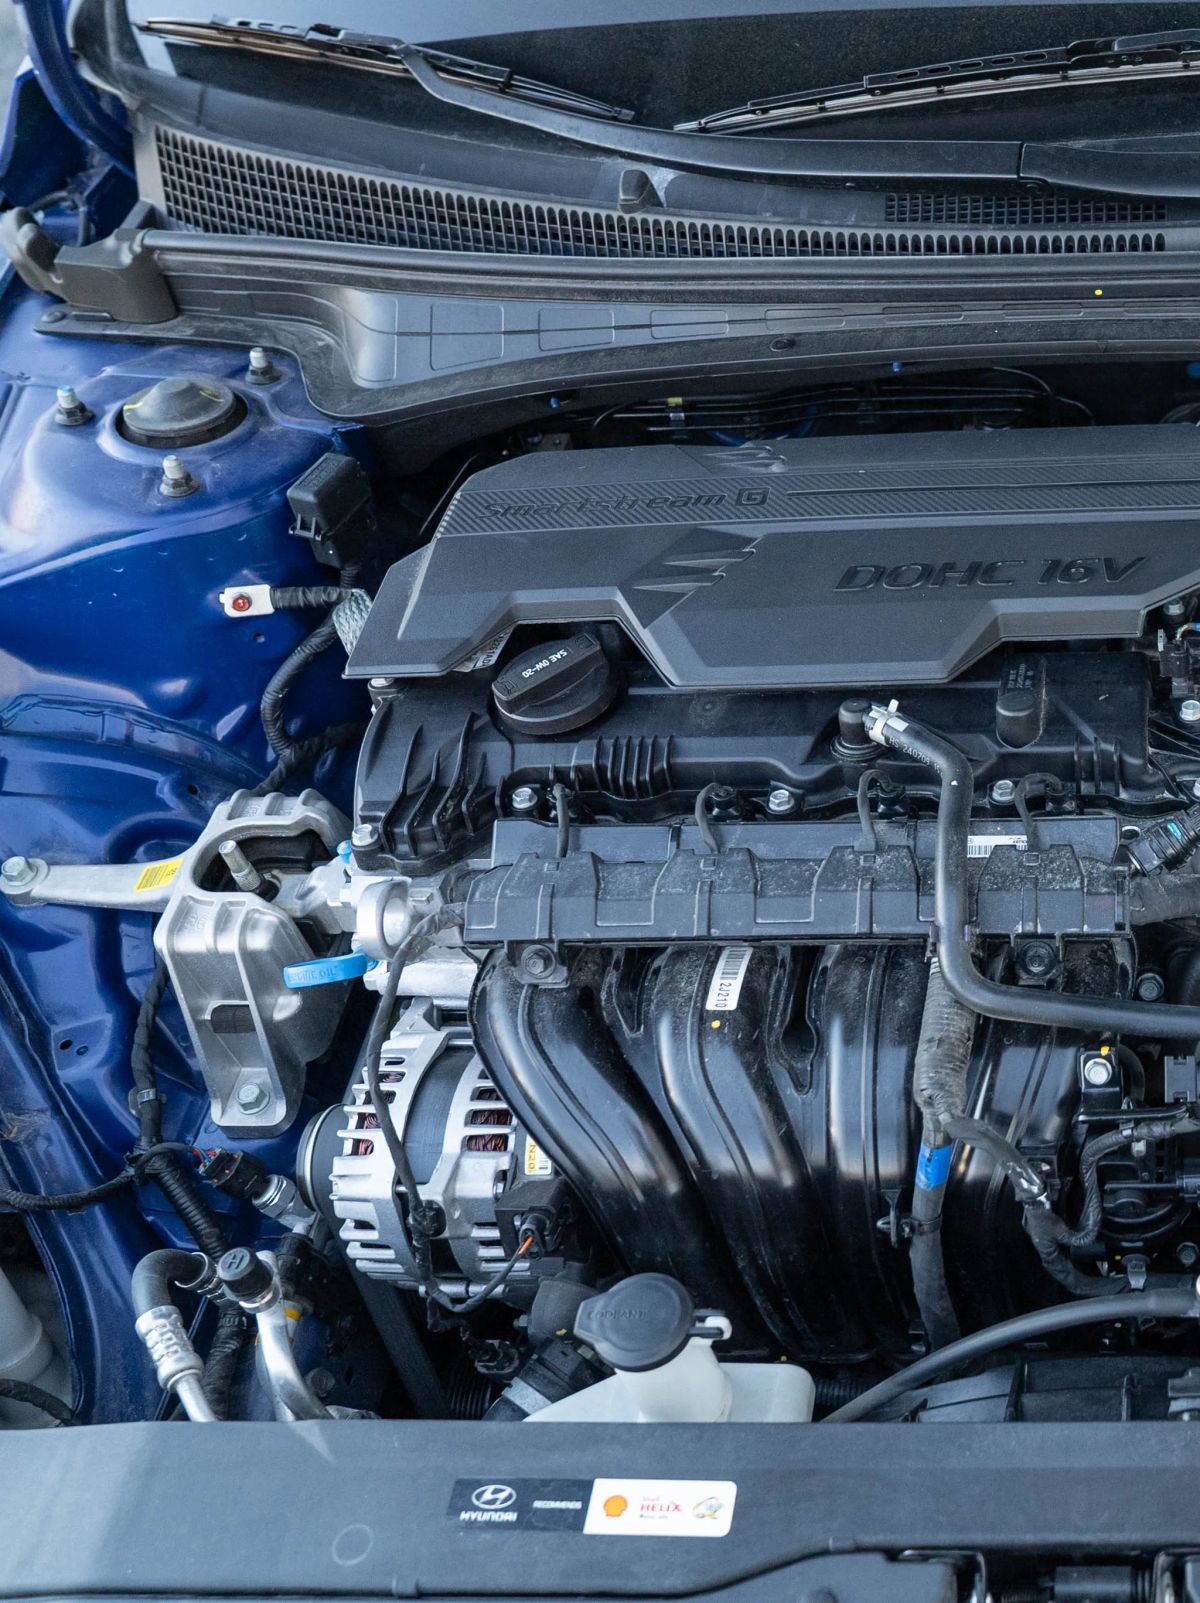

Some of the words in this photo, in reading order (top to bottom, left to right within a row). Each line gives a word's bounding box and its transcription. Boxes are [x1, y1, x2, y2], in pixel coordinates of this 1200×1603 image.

[476, 494, 727, 518] Smartstream
[833, 560, 1026, 592] DOHC
[1037, 556, 1147, 585] 16V
[549, 649, 568, 663] SAE
[521, 659, 550, 678] 0W-20
[715, 982, 732, 1008] 2J210
[587, 1308, 648, 1320] COOLANT
[640, 1503, 682, 1512] HELIX
[460, 1511, 518, 1522] HYUNDAI
